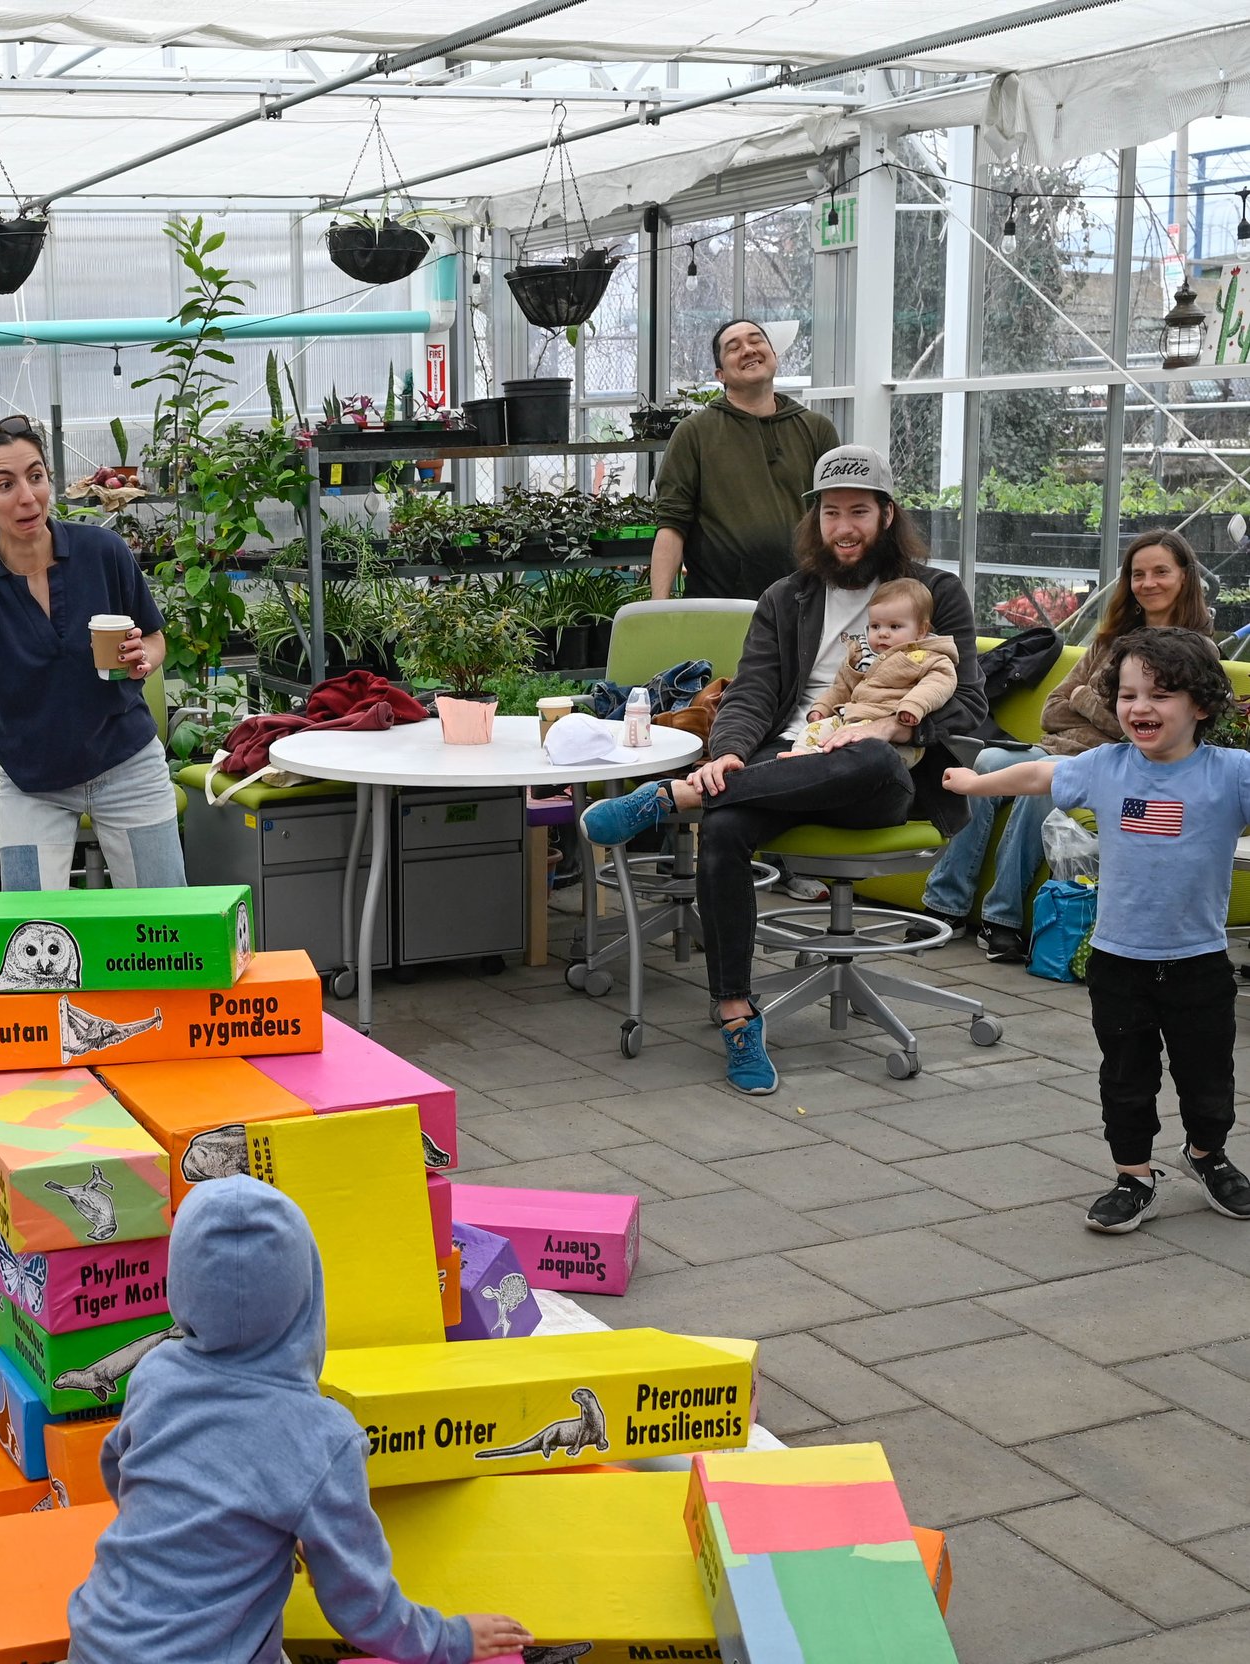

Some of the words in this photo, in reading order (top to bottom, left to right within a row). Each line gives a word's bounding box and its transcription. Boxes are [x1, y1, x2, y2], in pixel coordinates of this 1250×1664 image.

[429, 350, 442, 359] FIRE
[819, 458, 870, 481] Eastie
[136, 923, 180, 944] Strix
[106, 952, 204, 972] occidentalis
[209, 993, 278, 1022] Pongo
[189, 1017, 301, 1048] pygmaeus
[544, 1235, 601, 1261] Cherry
[80, 1258, 150, 1288] Phyllira
[537, 1258, 607, 1281] Sandbar
[73, 1293, 118, 1319] Tiger
[636, 1383, 738, 1412] Pteronura
[364, 1424, 426, 1456] Giant
[434, 1417, 497, 1449] Otter
[625, 1410, 742, 1447] brasiliensis
